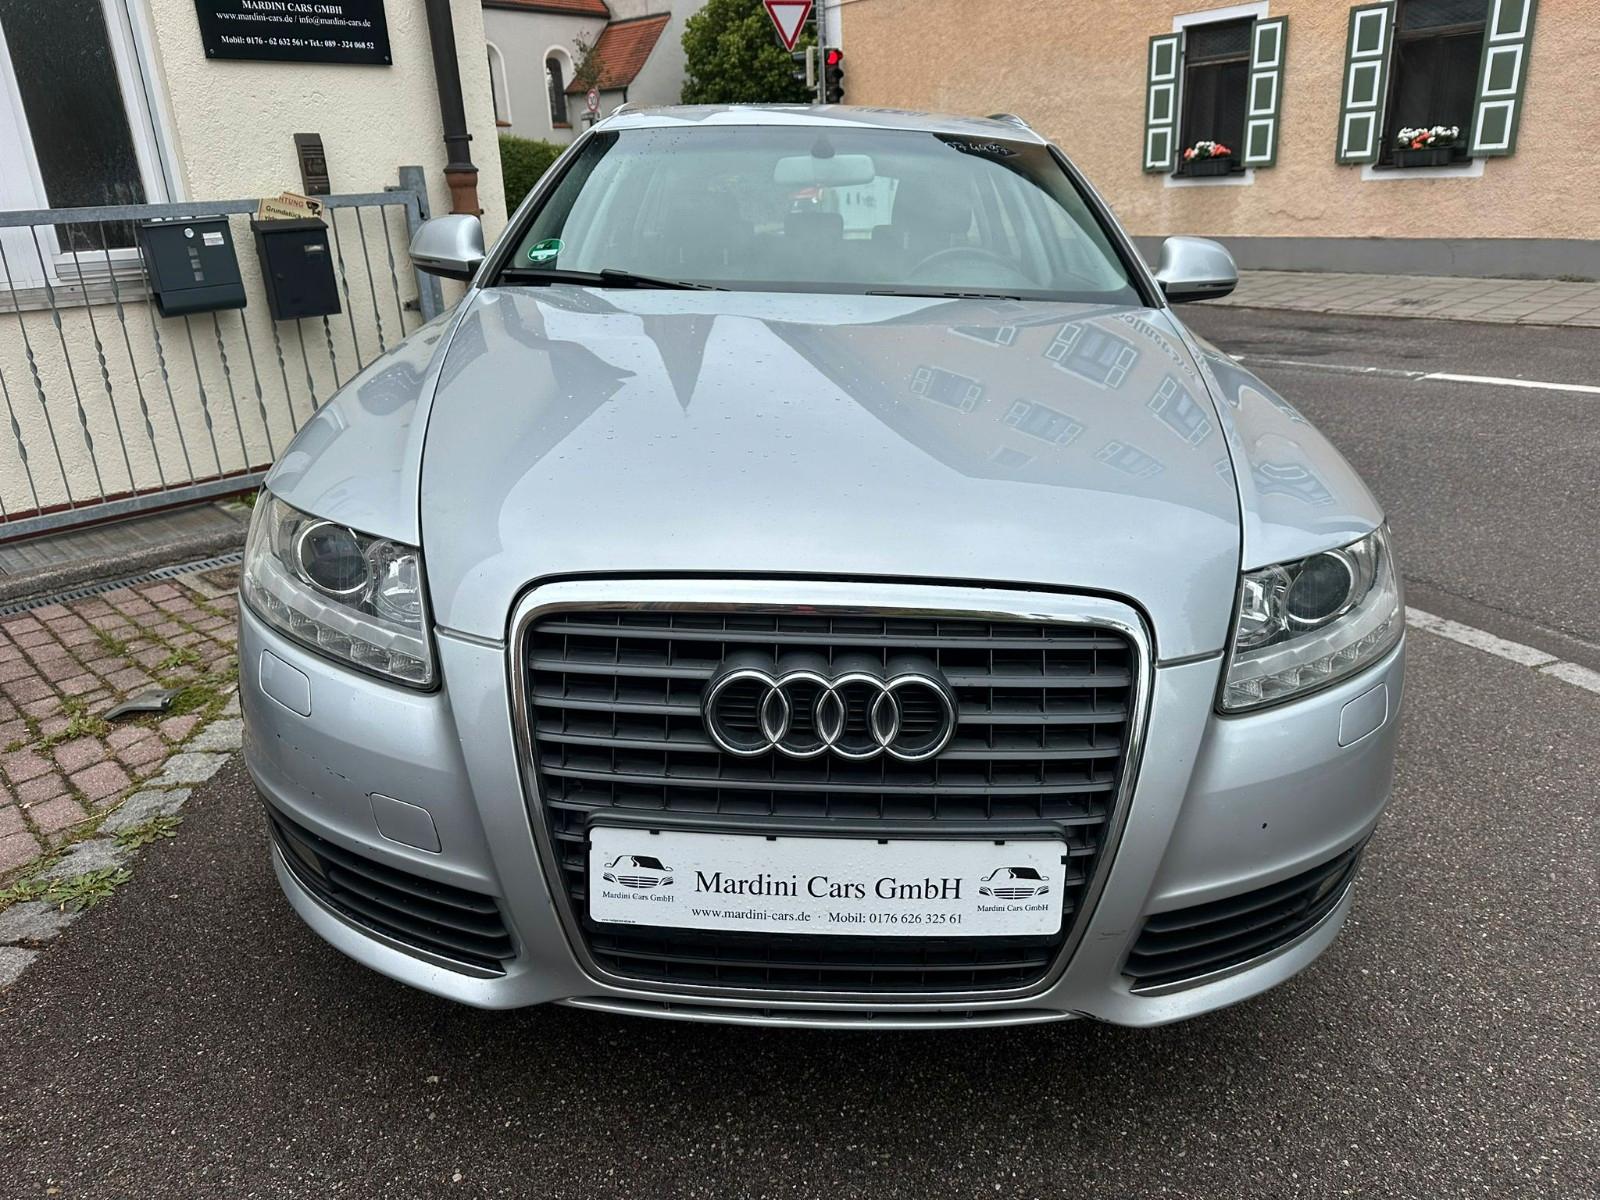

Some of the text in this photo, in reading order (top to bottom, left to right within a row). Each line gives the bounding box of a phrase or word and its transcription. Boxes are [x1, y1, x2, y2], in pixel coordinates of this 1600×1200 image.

[242, 0, 343, 14] MARDINI CARS GMBH
[216, 12, 293, 23] www.mardini-cars.de
[299, 14, 371, 27] info@mardini-cars.de
[221, 35, 245, 44] Mobil:
[246, 36, 263, 45] 0176
[269, 37, 278, 46] 62
[279, 38, 291, 46] 632
[292, 38, 304, 47] 561
[354, 41, 366, 49] 068
[695, 871, 963, 900] Mardini Cars GmbH
[602, 891, 675, 903] Mardini Cars GmbH
[1006, 904, 1023, 912] Cars
[1024, 904, 1049, 912] GmbH
[692, 908, 811, 922] www.mardini-cars.de
[828, 912, 866, 923] Mobil:
[869, 913, 898, 924] 0176
[901, 913, 922, 924] 626
[925, 913, 946, 924] 325
[949, 913, 962, 924] 61
